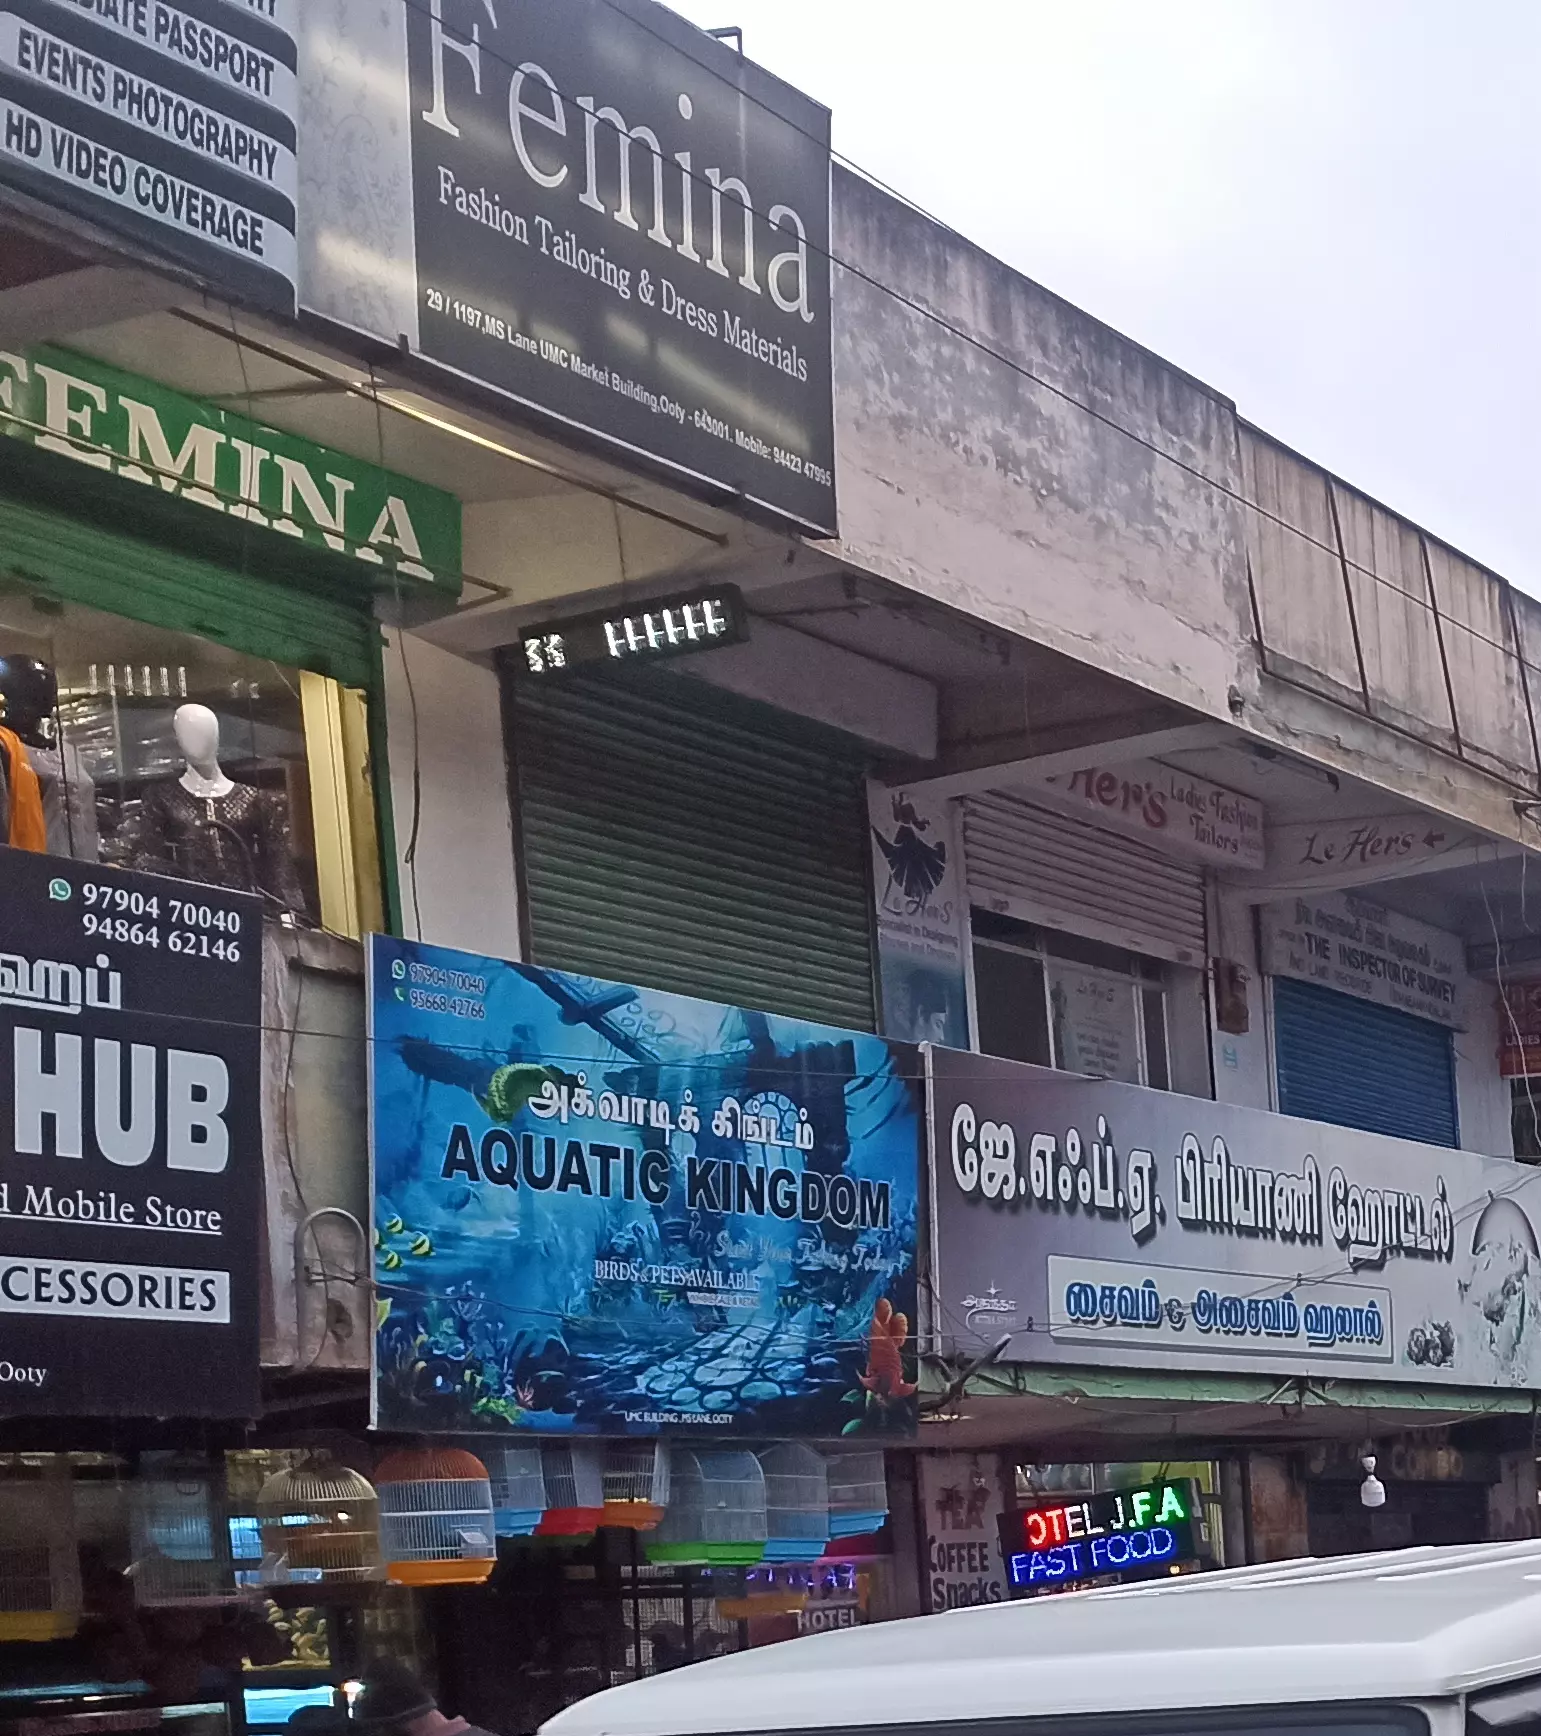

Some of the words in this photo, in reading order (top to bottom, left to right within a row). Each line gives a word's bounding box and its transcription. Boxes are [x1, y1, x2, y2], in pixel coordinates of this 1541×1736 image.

[154, 6, 275, 97] PASSPORT
[18, 27, 106, 103] EVENTS
[112, 69, 278, 182] PHOTOGRAPHY
[5, 108, 42, 158] HD
[50, 127, 127, 195] VIDEO
[134, 166, 264, 257] COVERAGE
[422, 0, 816, 324] Femina
[437, 164, 530, 247] Fashion
[534, 214, 631, 300] Tailoring
[638, 268, 655, 306] &
[661, 277, 718, 339] Dress
[723, 310, 808, 382] Materials
[426, 287, 442, 312] 29
[508, 324, 538, 356] Lane
[540, 339, 568, 369] UMC
[570, 353, 610, 388] Market
[1299, 833, 1334, 865] Le
[82, 883, 161, 921] 97904
[168, 901, 241, 934] 70040
[82, 913, 160, 949] 94864
[167, 929, 241, 963] 62146
[409, 963, 448, 993] 97904
[449, 969, 485, 995] 70040
[1305, 932, 1331, 961] THE
[1338, 942, 1401, 984] INSPECTOR
[1402, 964, 1416, 988] OF
[1417, 970, 1456, 1004] SURVEY
[410, 989, 448, 1016] 95668
[449, 993, 485, 1019] 42766
[1505, 1034, 1540, 1046] LADIES
[14, 1026, 230, 1173] HUB
[528, 1070, 701, 1145] அக்வாடிக்
[711, 1096, 814, 1152] கிங்டம்
[440, 1122, 671, 1205] AQUATIC
[686, 1156, 890, 1232] KINGDOM
[1174, 1133, 1321, 1236] பிரியாணி
[1328, 1166, 1456, 1267] ஹோட்டல்
[22, 1186, 135, 1224] Mobile
[144, 1197, 222, 1232] Store
[595, 1260, 638, 1282] BIRDS
[686, 1269, 761, 1292] AVAILABLE
[1065, 1277, 1160, 1326] சைவம்
[1191, 1290, 1300, 1337] அசைவம்
[1304, 1300, 1384, 1348] ஹலால்
[0, 1361, 47, 1387] Ooty
[929, 1535, 988, 1574] COFFEE
[1010, 1543, 1082, 1586] FAST
[1092, 1527, 1173, 1565] FOOD
[796, 1608, 857, 1630] HOTEL
[932, 1577, 1000, 1611] Snacks
